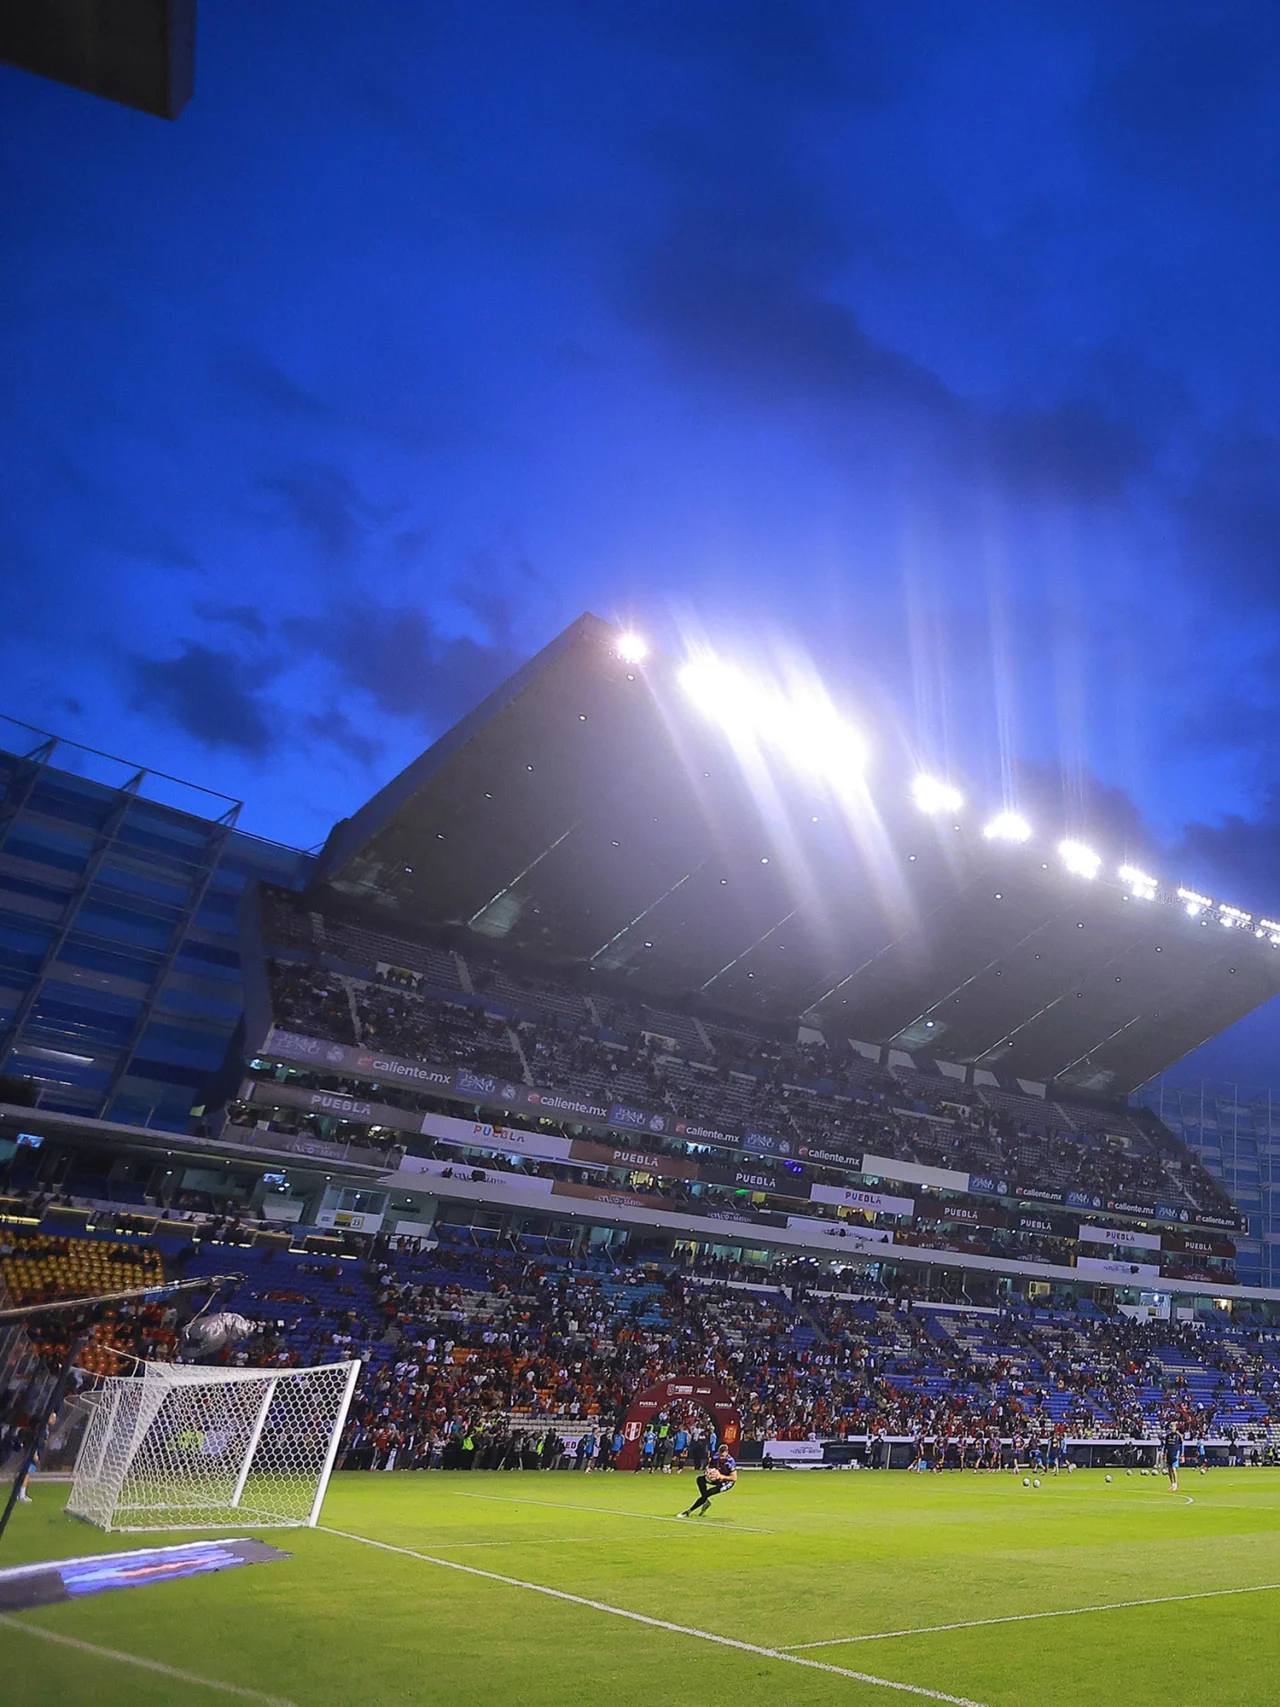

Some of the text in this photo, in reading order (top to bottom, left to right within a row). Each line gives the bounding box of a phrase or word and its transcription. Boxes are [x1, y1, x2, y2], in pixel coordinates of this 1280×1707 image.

[372, 1057, 452, 1085] caliente.mx
[540, 1094, 607, 1117] caliente.mx
[686, 1126, 739, 1144] caliente.mx
[808, 1149, 861, 1166] caliente.mx
